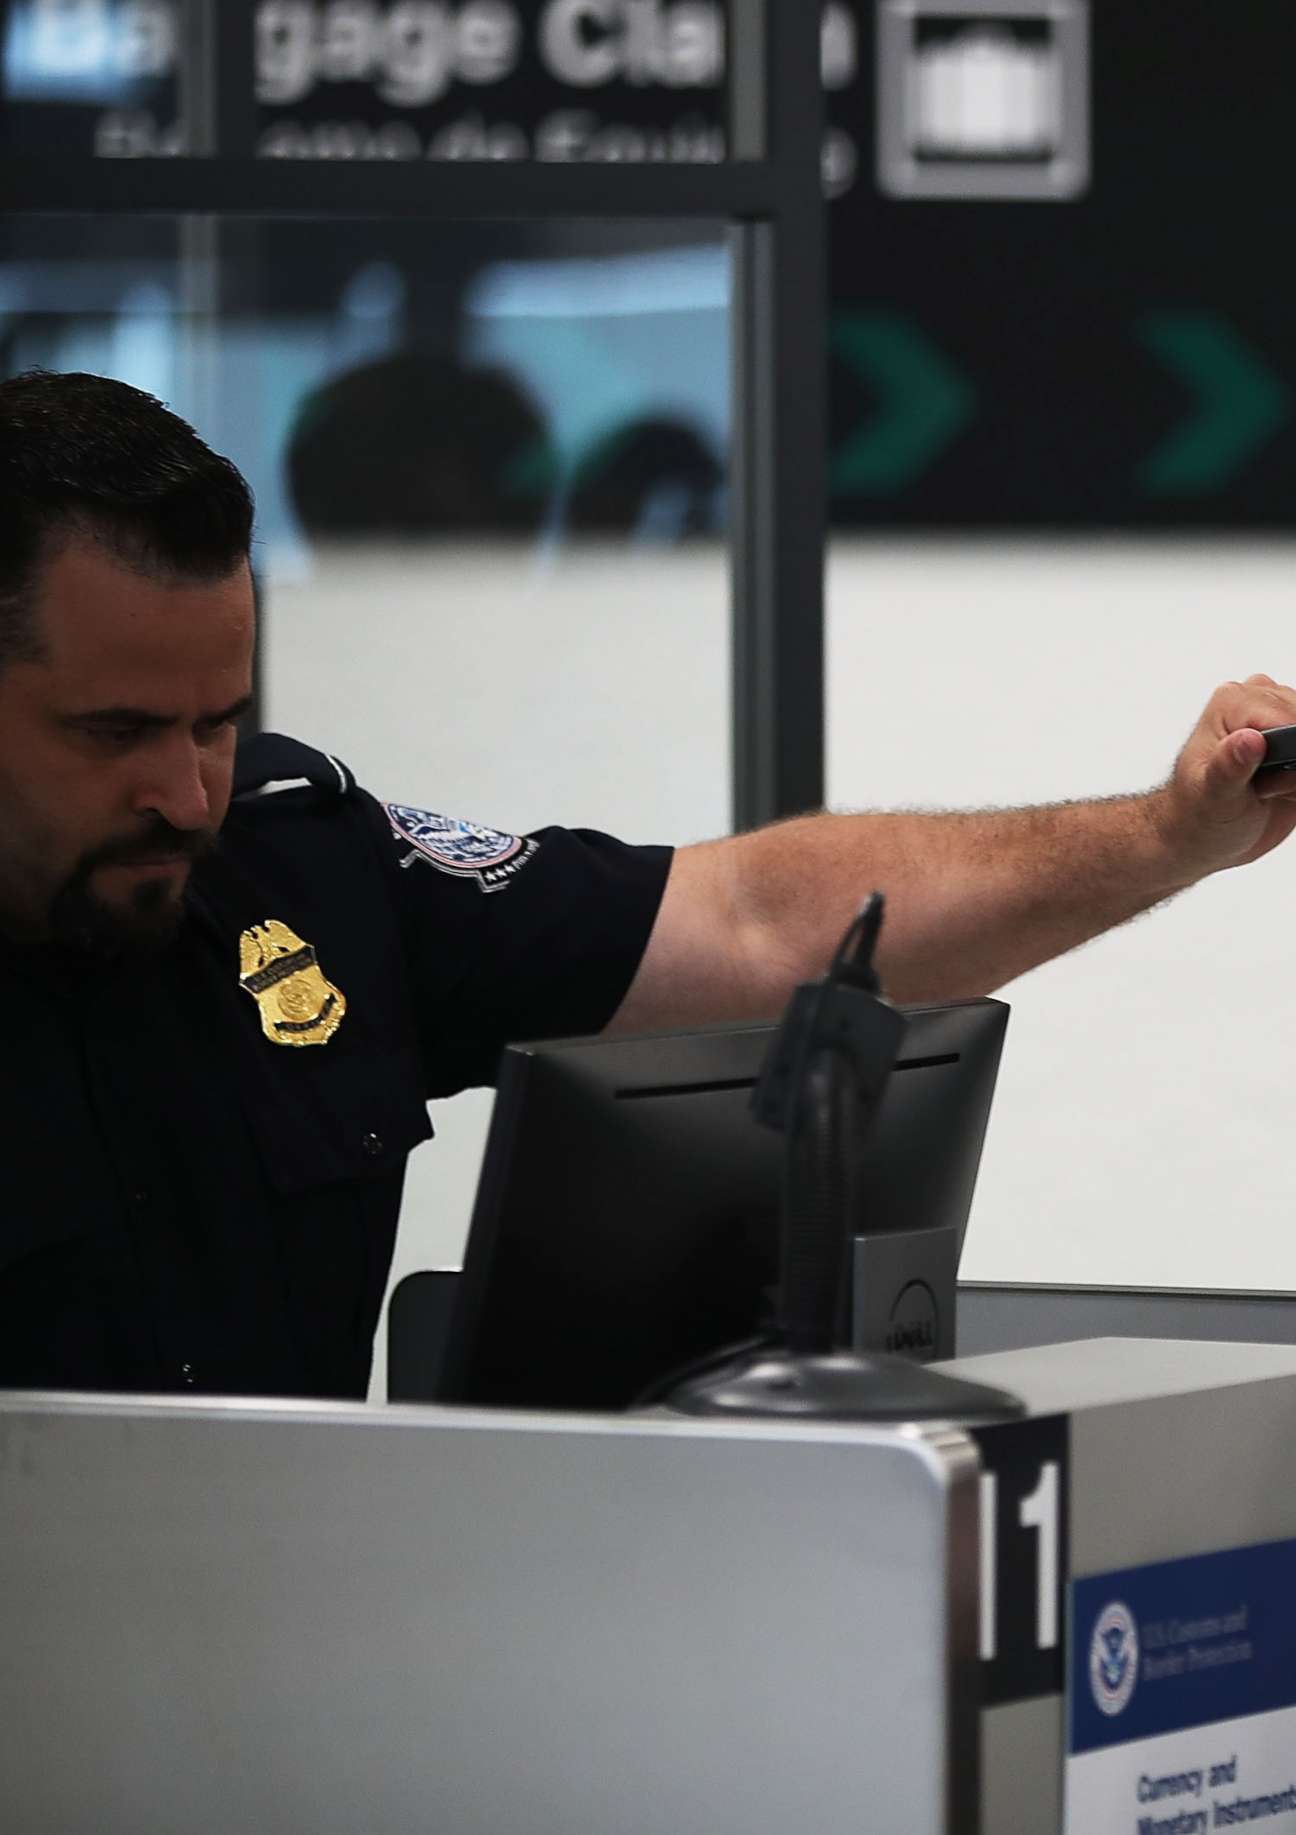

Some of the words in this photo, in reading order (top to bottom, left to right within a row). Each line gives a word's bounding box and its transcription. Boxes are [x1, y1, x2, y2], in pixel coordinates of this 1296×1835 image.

[1138, 1770, 1203, 1803] Currency
[1209, 1754, 1237, 1788] and
[1137, 1811, 1208, 1835] Monetary
